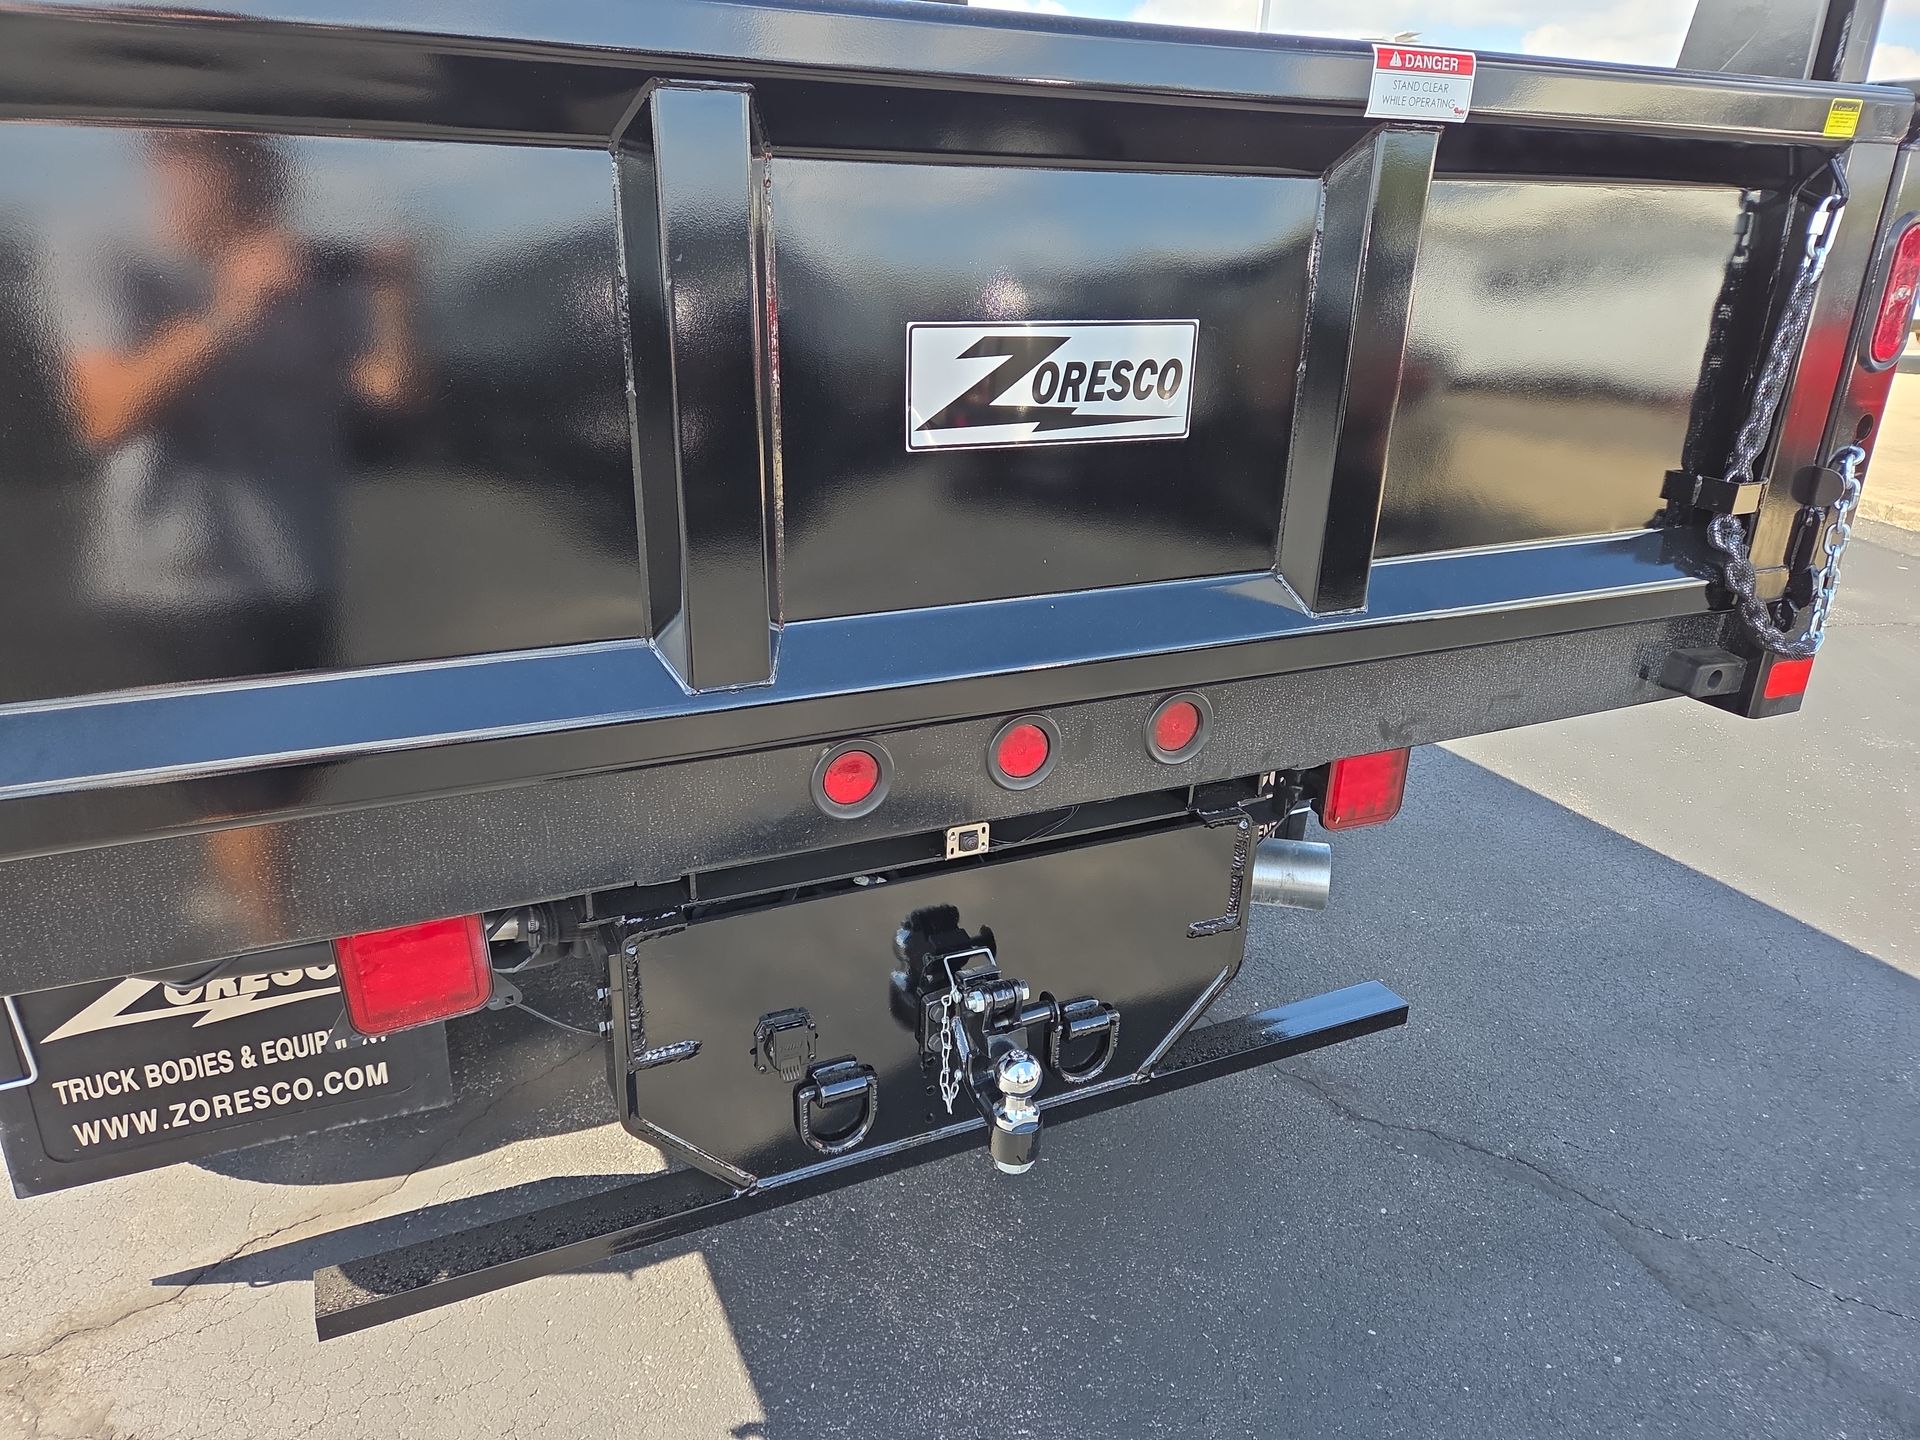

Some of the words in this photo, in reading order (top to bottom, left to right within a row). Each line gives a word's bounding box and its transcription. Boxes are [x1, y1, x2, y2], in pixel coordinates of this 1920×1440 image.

[1405, 53, 1459, 71] DANGER
[1382, 95, 1407, 106] WHILE
[1408, 96, 1456, 109] OPERATING
[1393, 80, 1420, 91] STAND
[1422, 82, 1449, 93] CLEAR
[914, 336, 1184, 432] ZORESCO
[52, 1067, 140, 1105] TRUCK
[144, 1050, 234, 1088] BODIES
[240, 1045, 258, 1069] &
[72, 1061, 389, 1146] WWW.ZORESCO.COM
